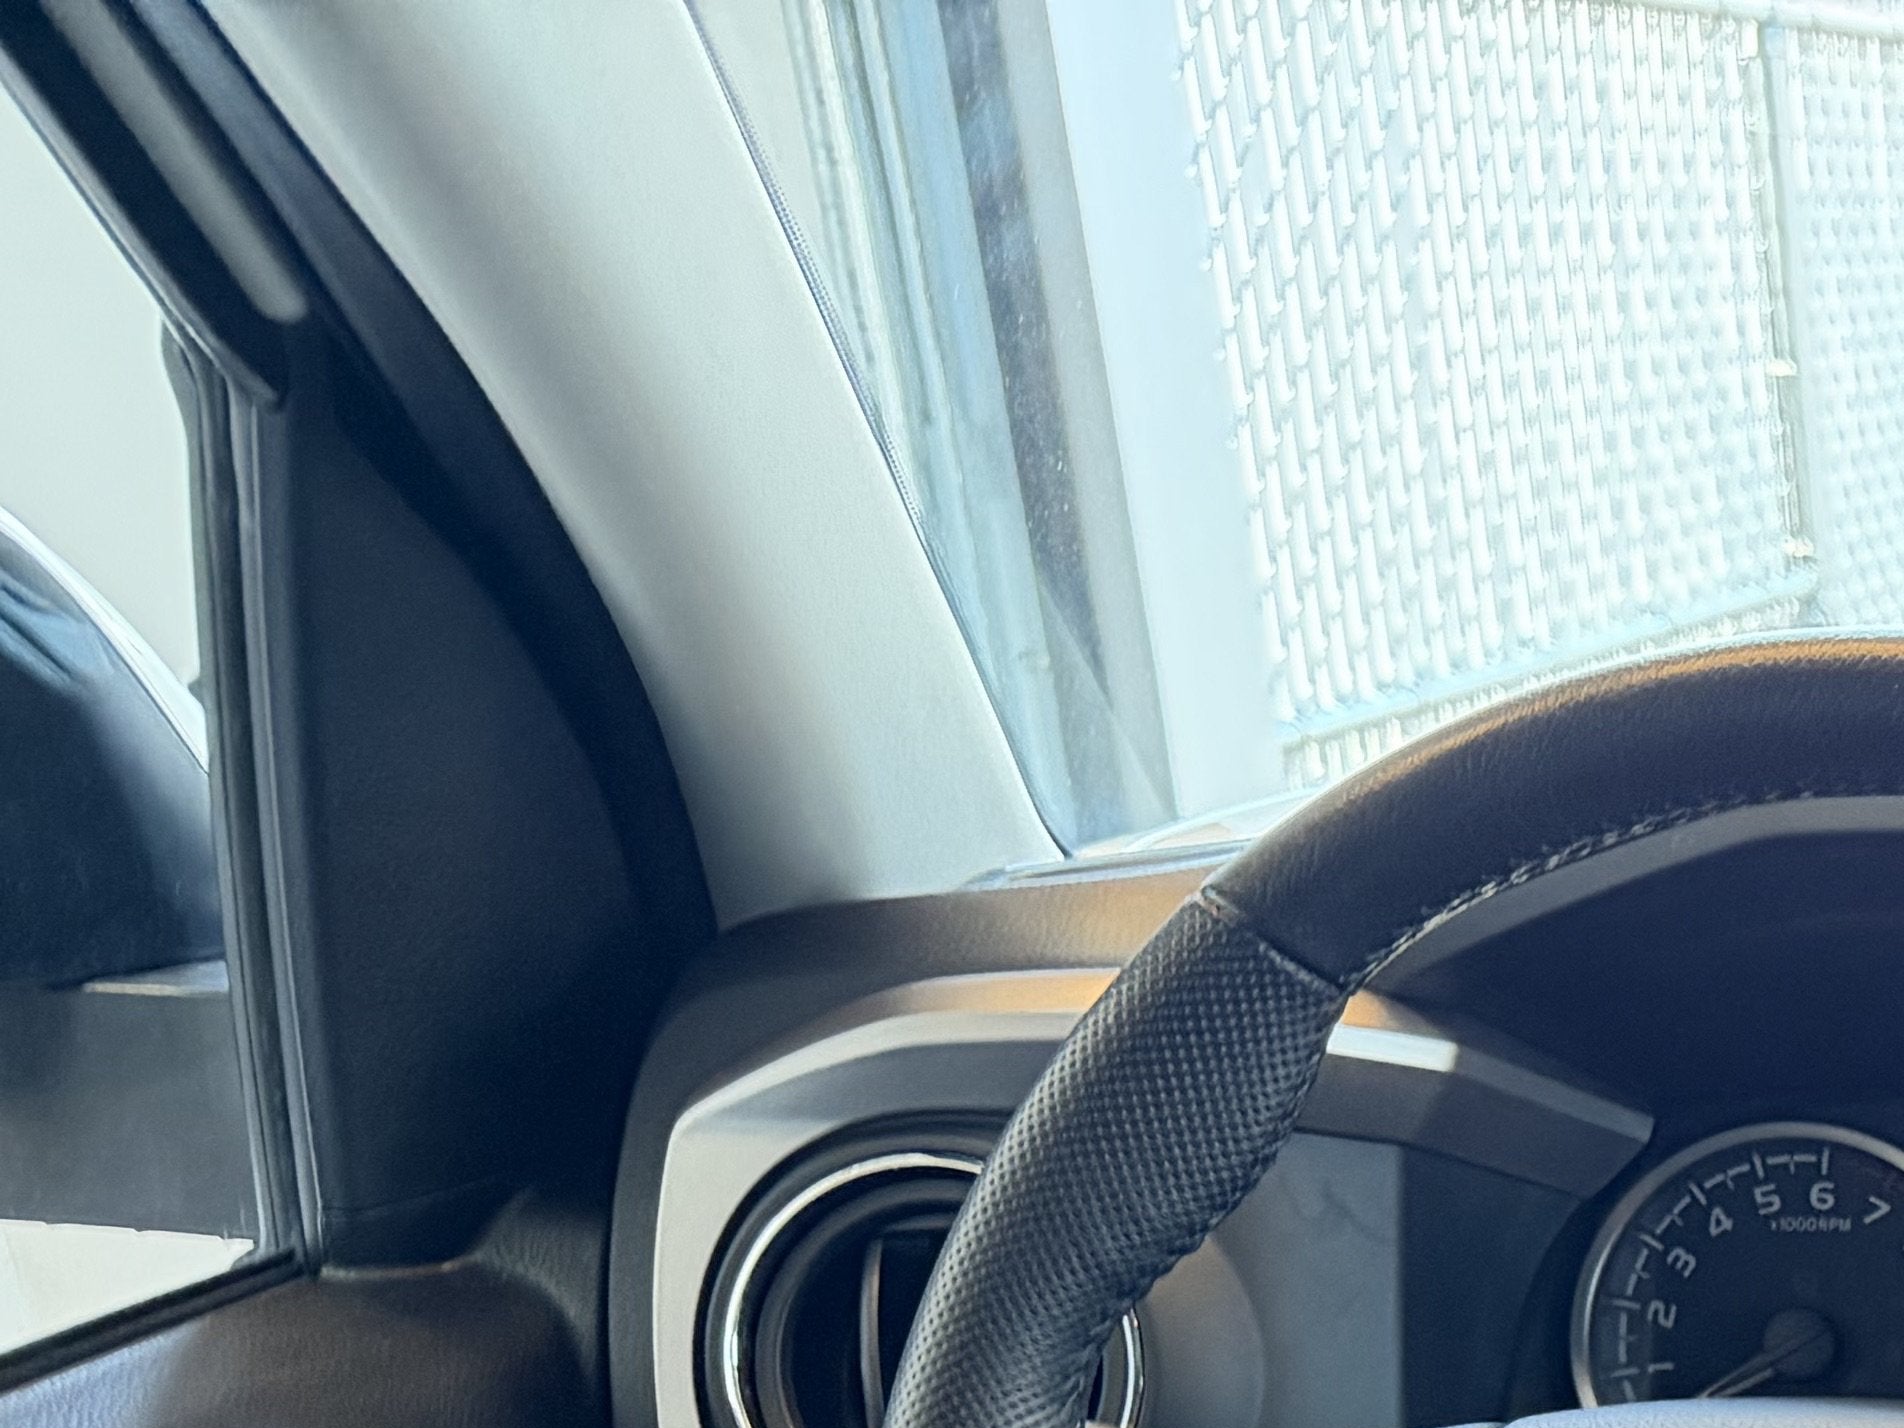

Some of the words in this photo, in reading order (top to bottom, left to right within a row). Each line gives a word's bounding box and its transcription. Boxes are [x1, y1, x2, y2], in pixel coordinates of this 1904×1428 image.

[1754, 1183, 1782, 1216] 5
[1810, 1181, 1836, 1210] 6
[1708, 1208, 1734, 1238] 4
[1863, 1197, 1892, 1225] 7
[1666, 1246, 1698, 1279] 3
[1647, 1300, 1678, 1329] 2
